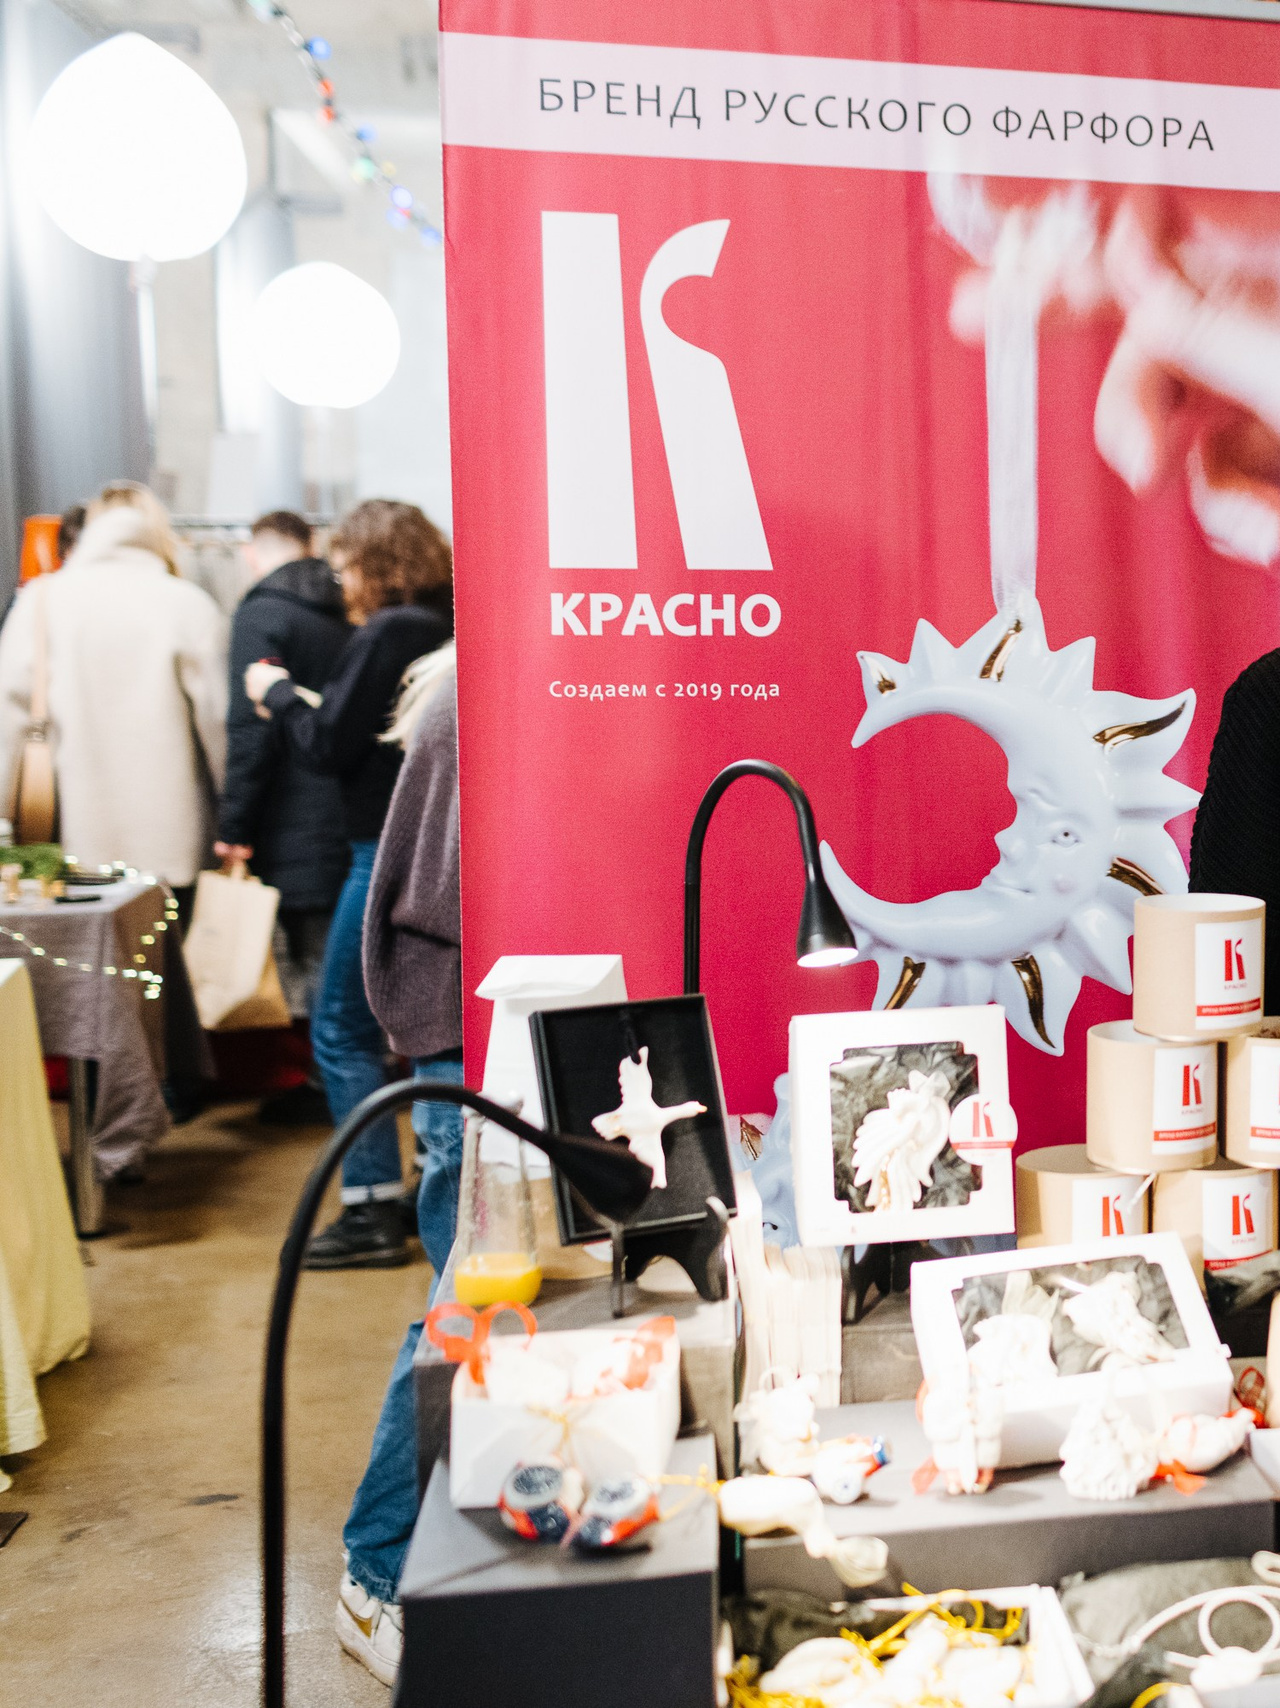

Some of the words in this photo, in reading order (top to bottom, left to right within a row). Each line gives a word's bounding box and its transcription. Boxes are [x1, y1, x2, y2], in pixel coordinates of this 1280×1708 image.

[539, 78, 702, 131] БРЕНД
[724, 89, 974, 138] РУССКОГО
[991, 105, 1217, 152] ФАРФОРА
[549, 592, 783, 638] КРАСНО
[548, 680, 647, 702] Создаем
[655, 684, 666, 697] с
[674, 683, 722, 701] 2019
[730, 684, 781, 701] года
